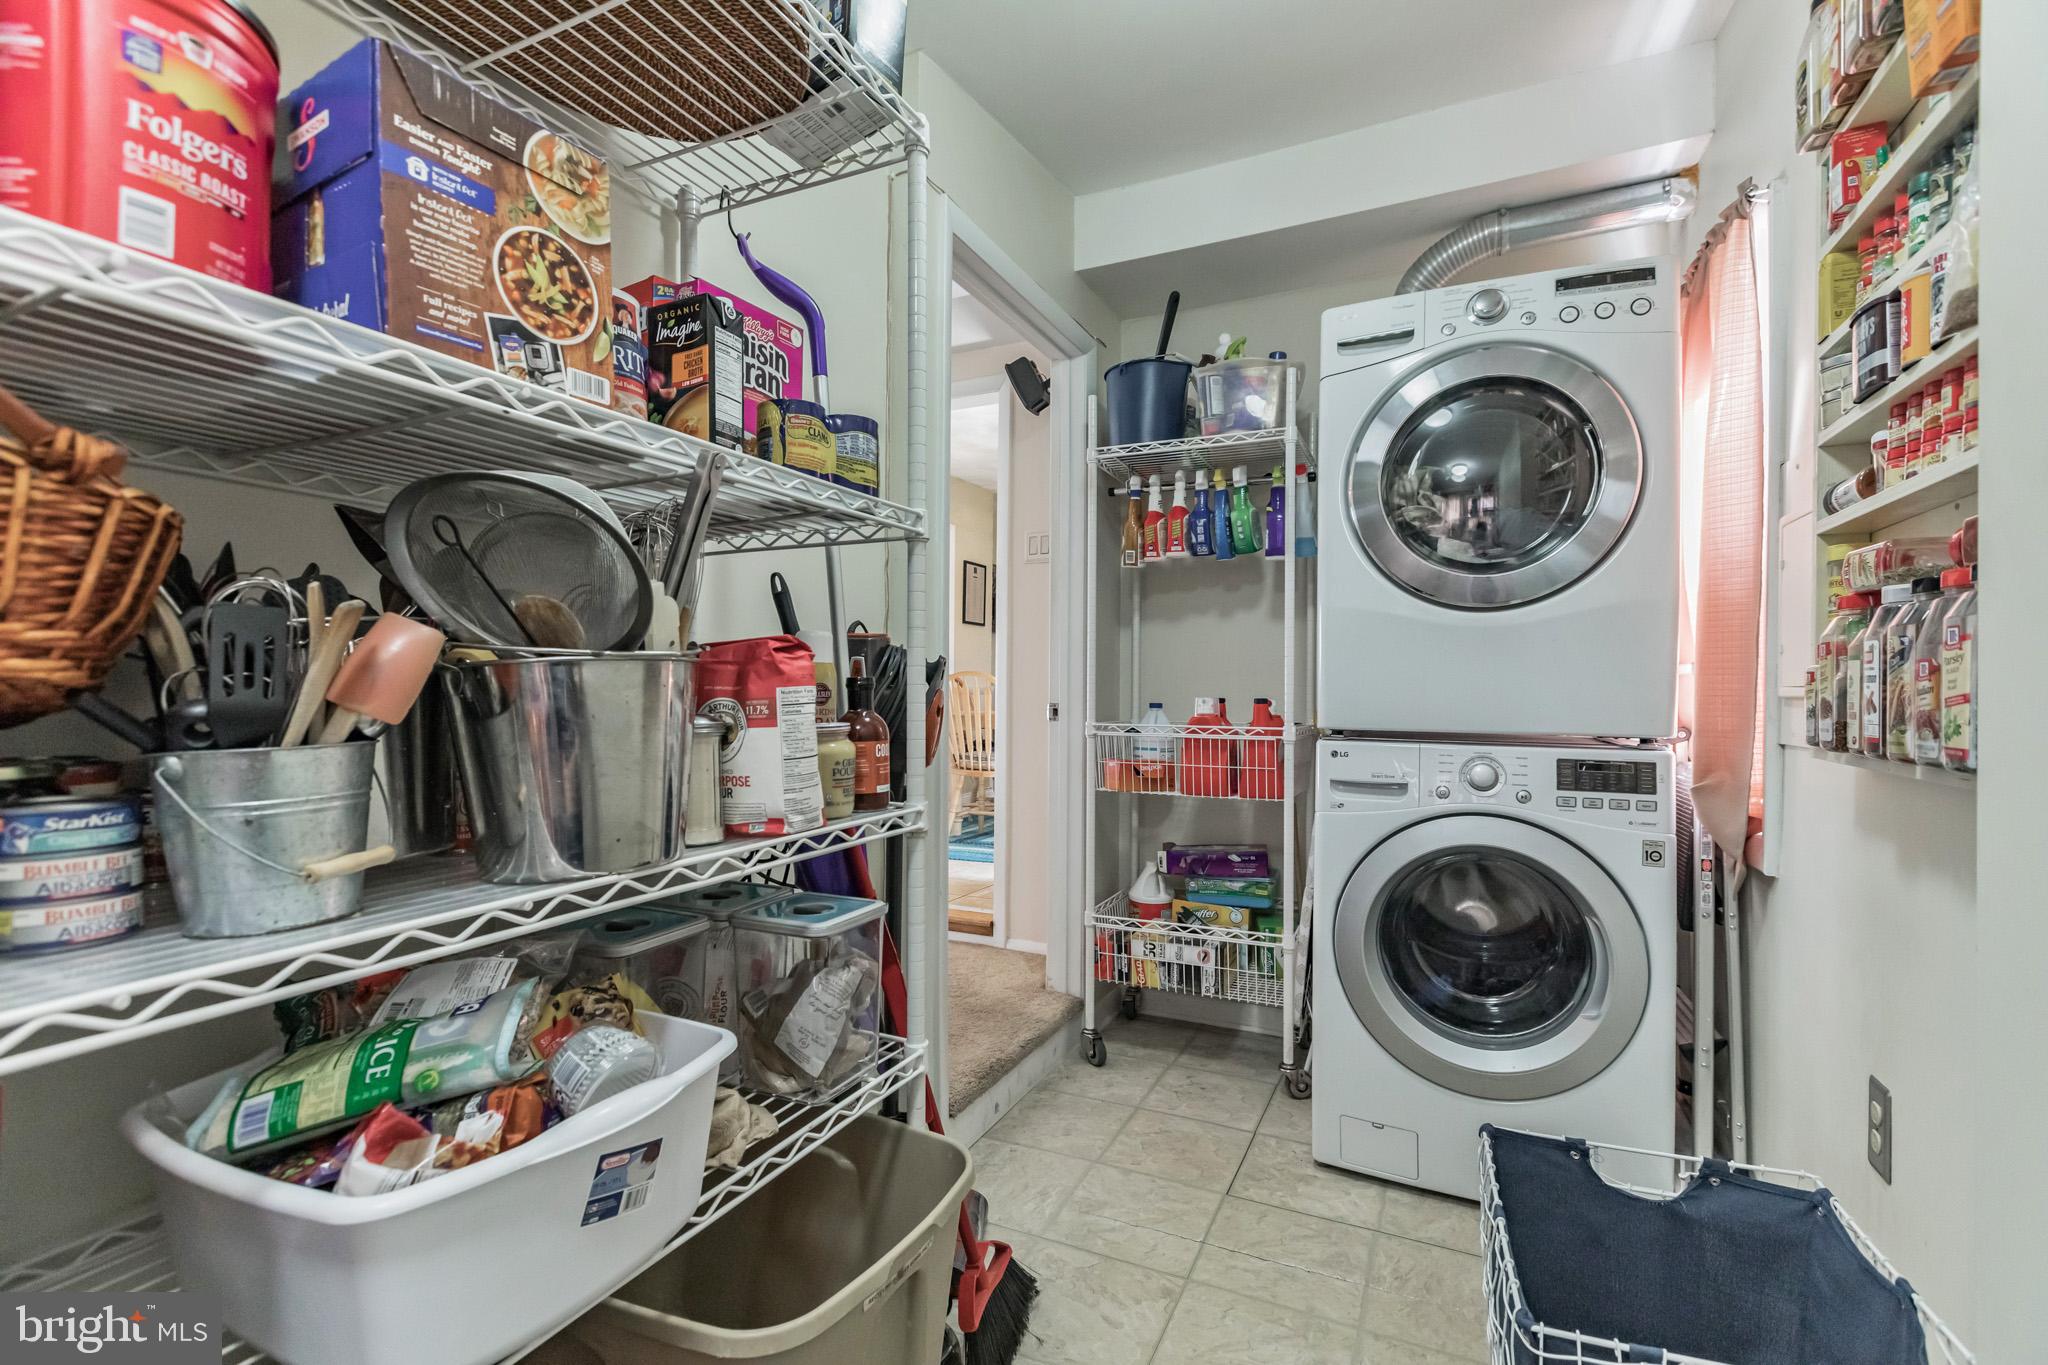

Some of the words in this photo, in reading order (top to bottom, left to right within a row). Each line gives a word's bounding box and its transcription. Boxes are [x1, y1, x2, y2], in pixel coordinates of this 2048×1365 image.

[127, 98, 248, 181] Folgers
[393, 113, 436, 143] Easier
[456, 144, 494, 171] Faster
[122, 140, 197, 183] CLASSIC
[200, 173, 248, 209] ROAST
[657, 303, 700, 321] ORGANIC
[612, 324, 639, 343] QUAKER
[655, 317, 703, 348] Imagine
[612, 344, 646, 382] RIT
[683, 356, 704, 370] CHICKEN
[743, 331, 789, 384] aisin
[687, 366, 704, 378] BROTH
[744, 362, 783, 400] ran
[807, 426, 830, 446] CLAMS
[708, 703, 737, 714] ARTHUR
[746, 705, 769, 715] 11.7%
[44, 812, 125, 831] StarKist
[23, 861, 99, 881] BUMBLE
[36, 870, 123, 896] Albacore
[44, 901, 116, 926] BUMBLE
[1195, 909, 1218, 918] iffer
[365, 1038, 399, 1083] ICE
